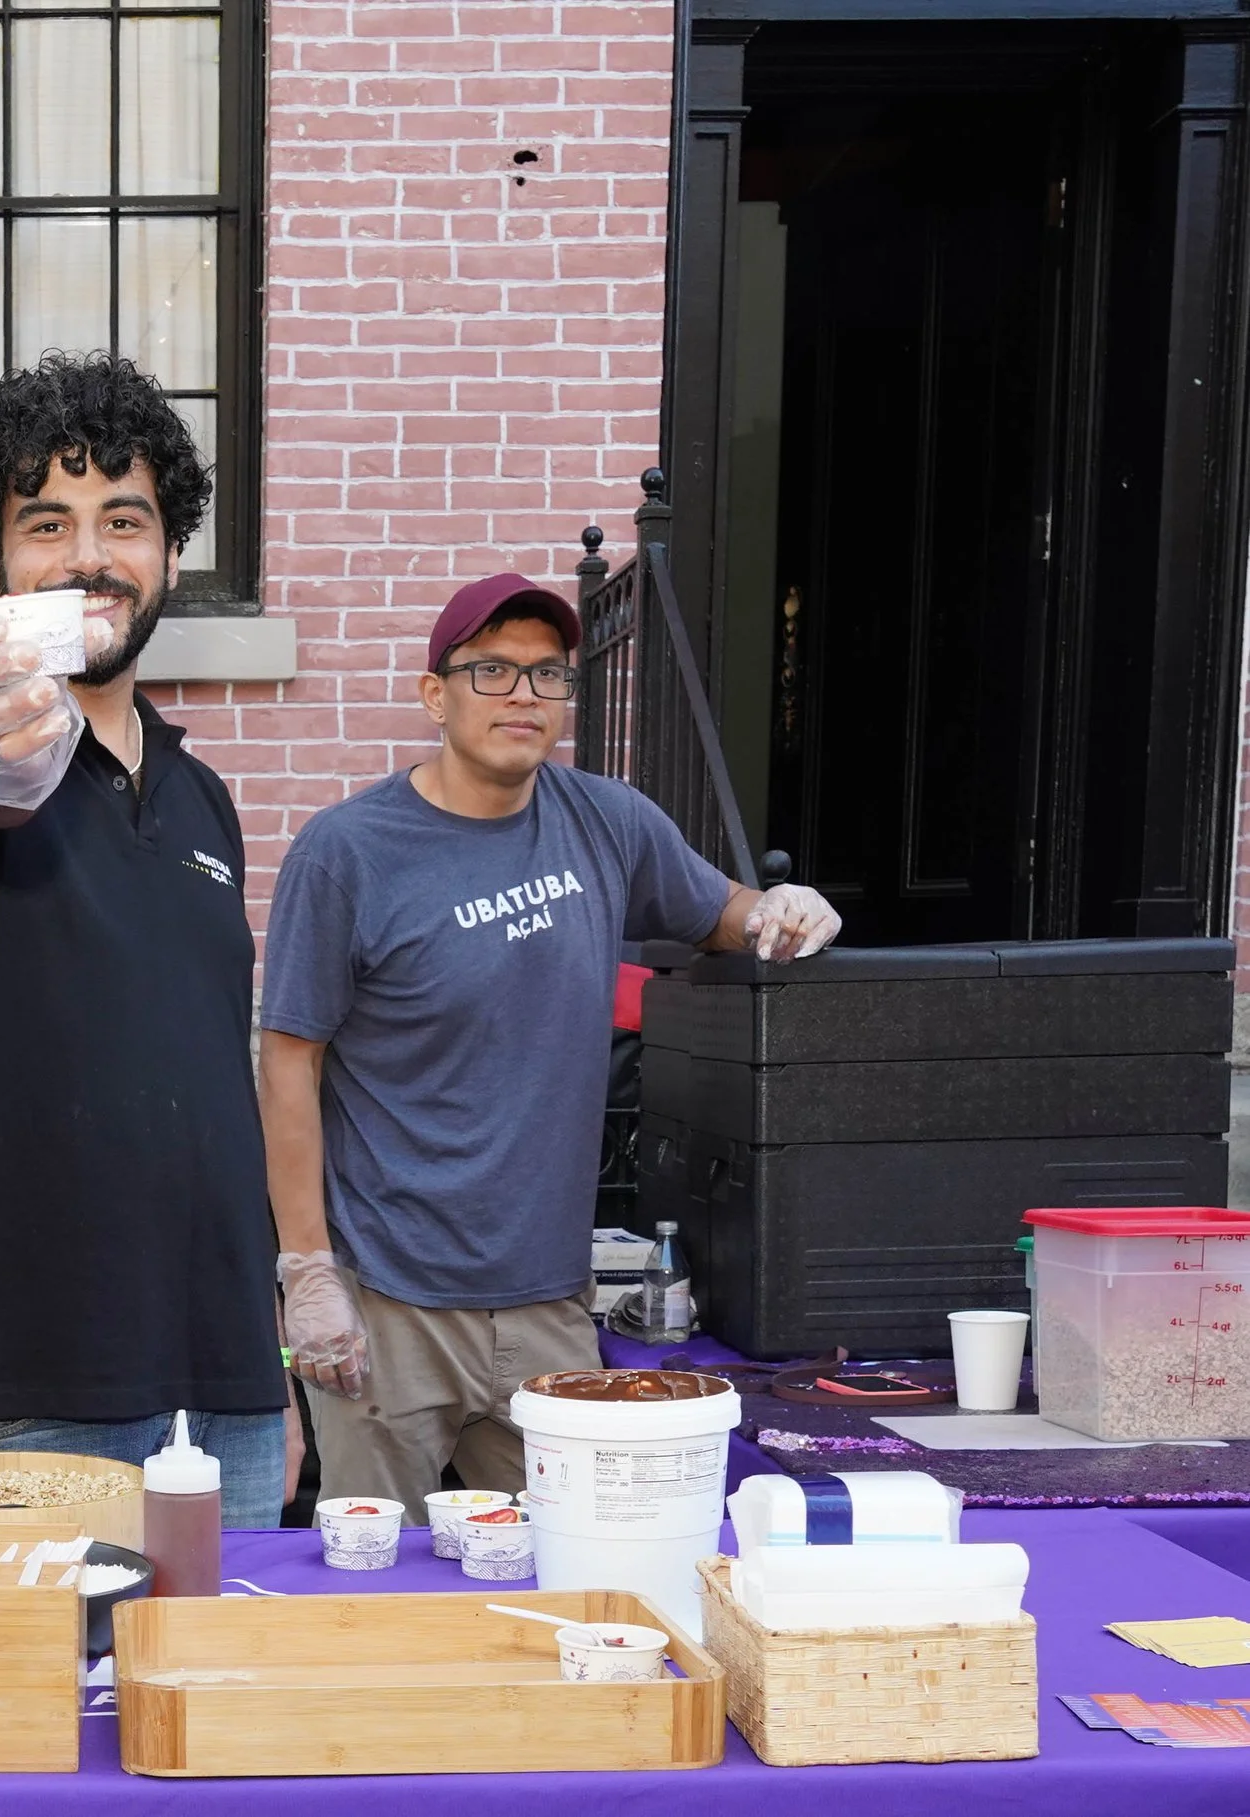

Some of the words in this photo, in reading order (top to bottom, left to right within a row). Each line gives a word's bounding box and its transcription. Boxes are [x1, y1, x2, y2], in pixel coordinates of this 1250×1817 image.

[193, 849, 232, 878] UBATUBA
[453, 870, 584, 929] UBATUBA
[506, 904, 553, 941] AÇAÍ
